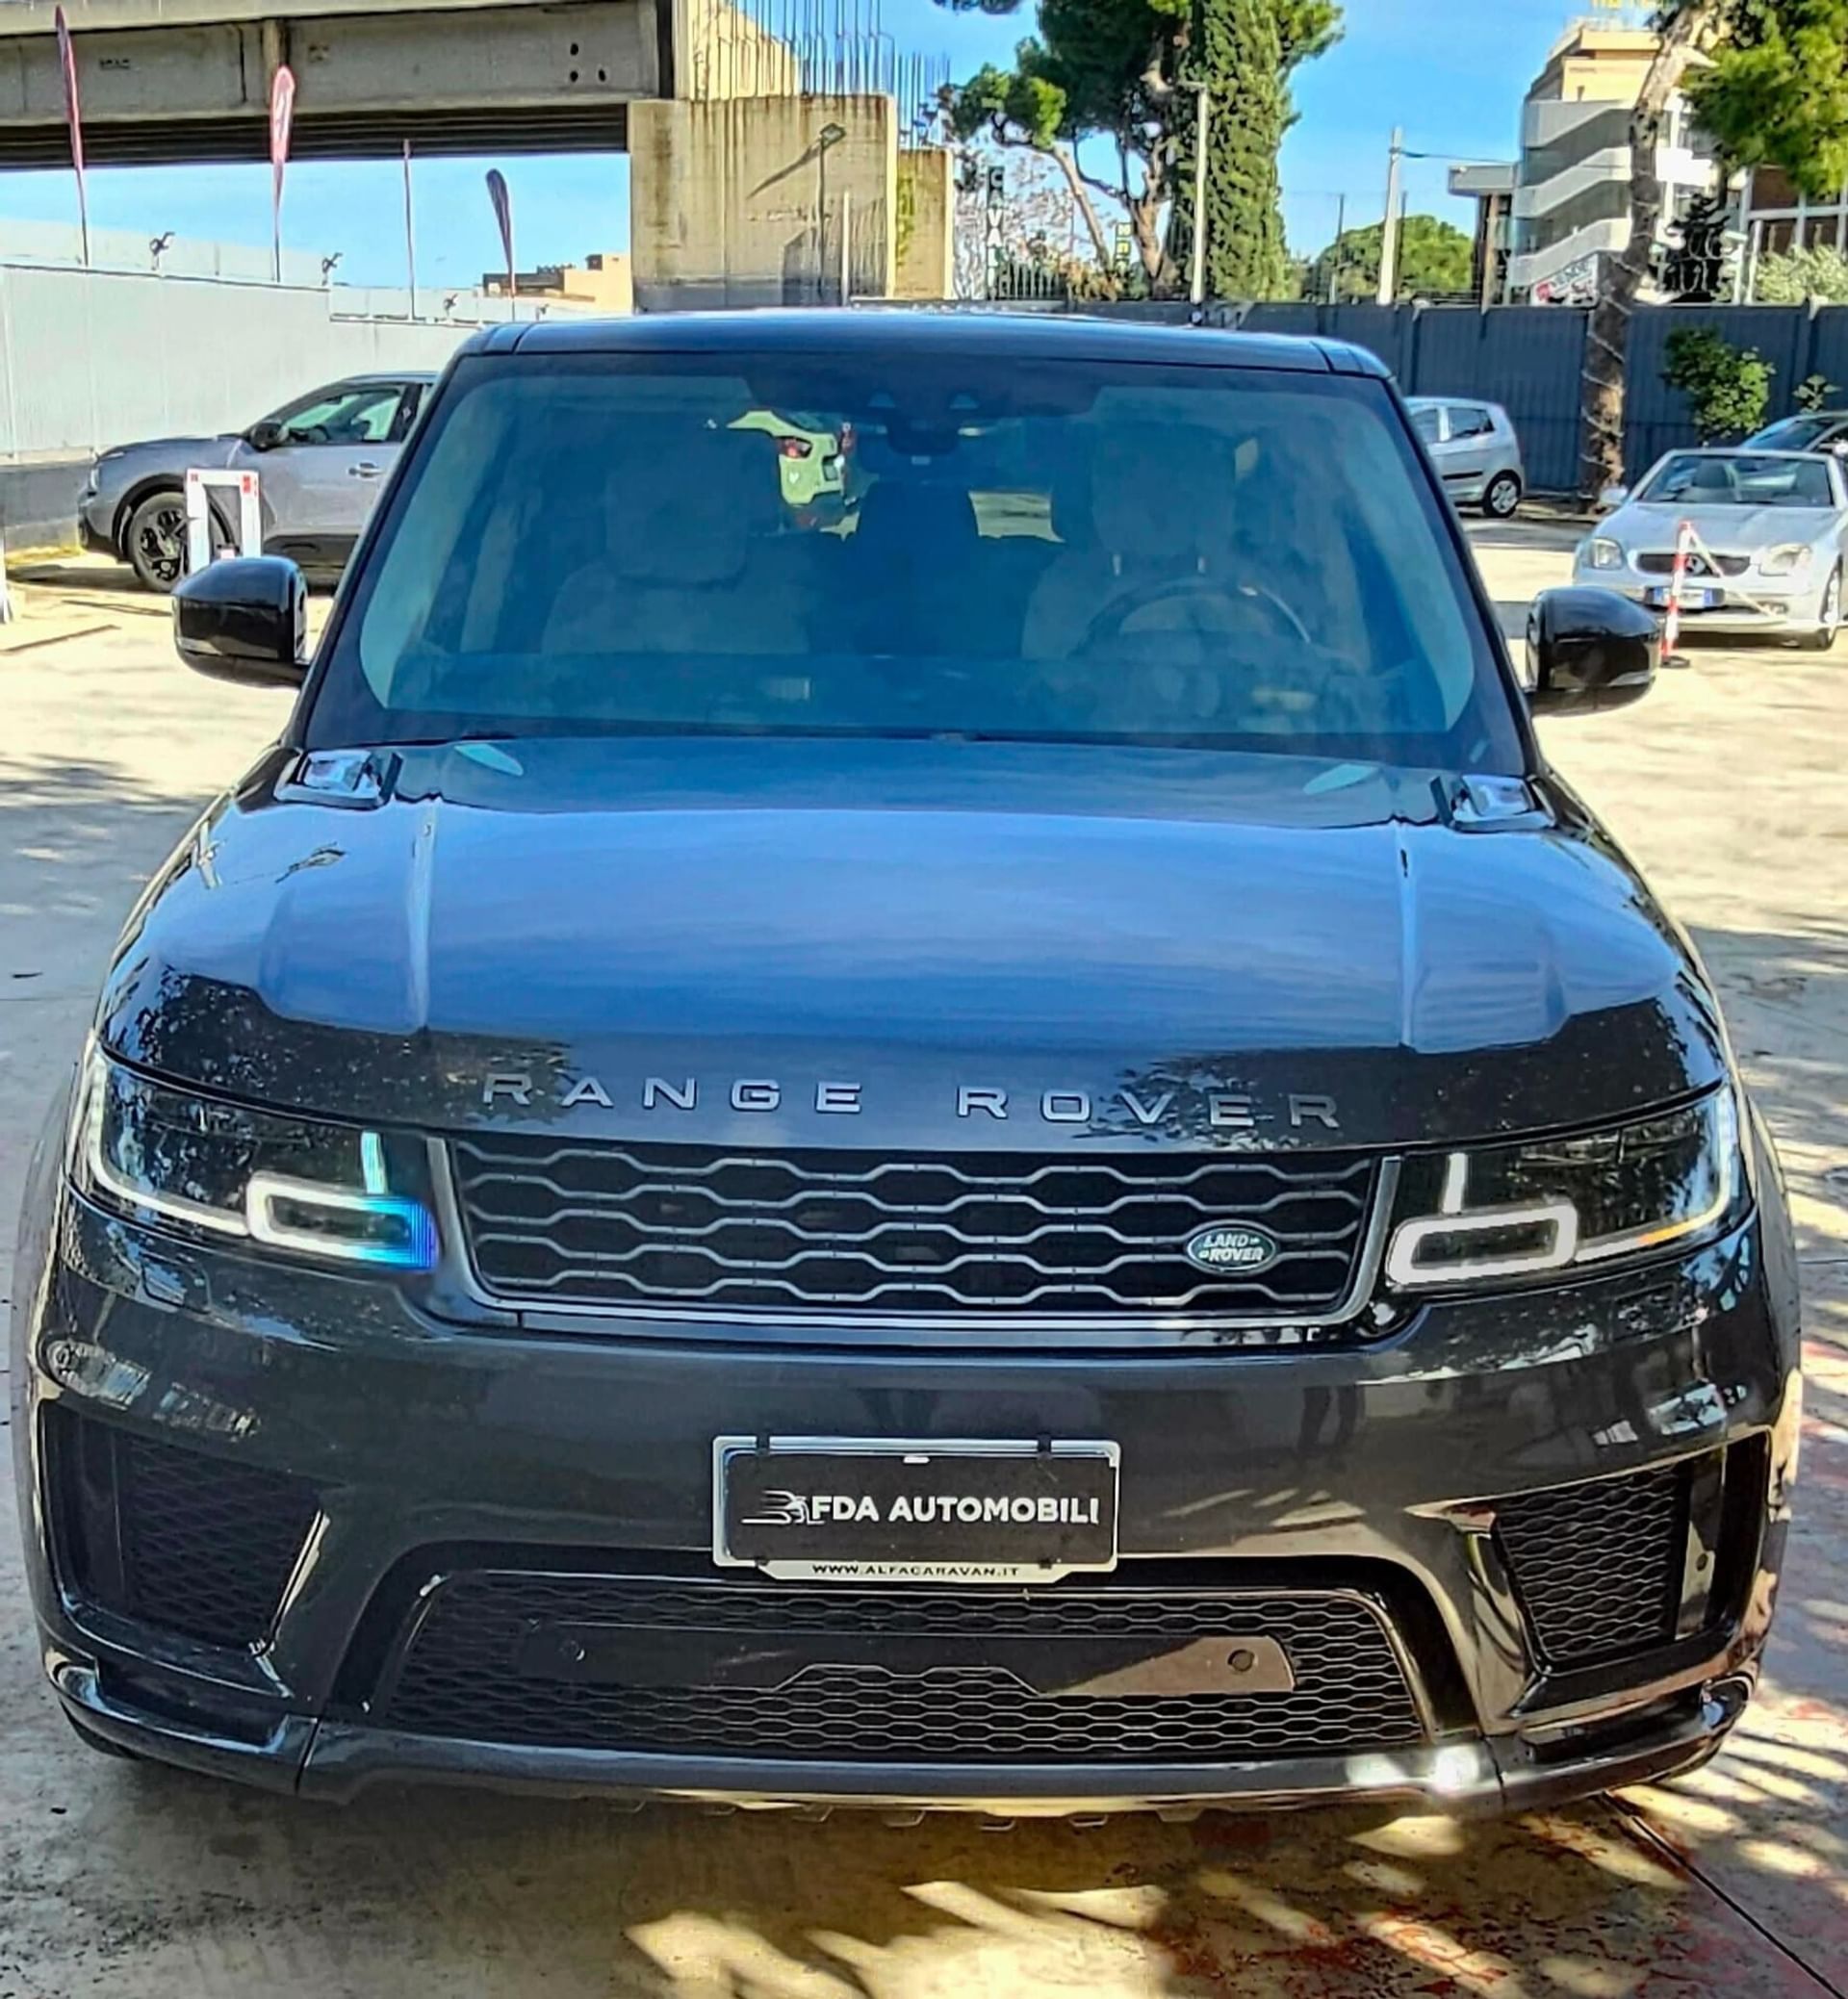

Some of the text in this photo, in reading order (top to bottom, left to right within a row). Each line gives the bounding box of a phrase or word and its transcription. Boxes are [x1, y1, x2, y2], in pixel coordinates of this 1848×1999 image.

[482, 1072, 1340, 1128] RANGE ROVER
[1209, 1246, 1265, 1262] ROVER
[811, 1496, 1099, 1525] FDA AUTOMOBILI
[812, 1564, 1020, 1576] WWW.ALFACARAVAN.IT
